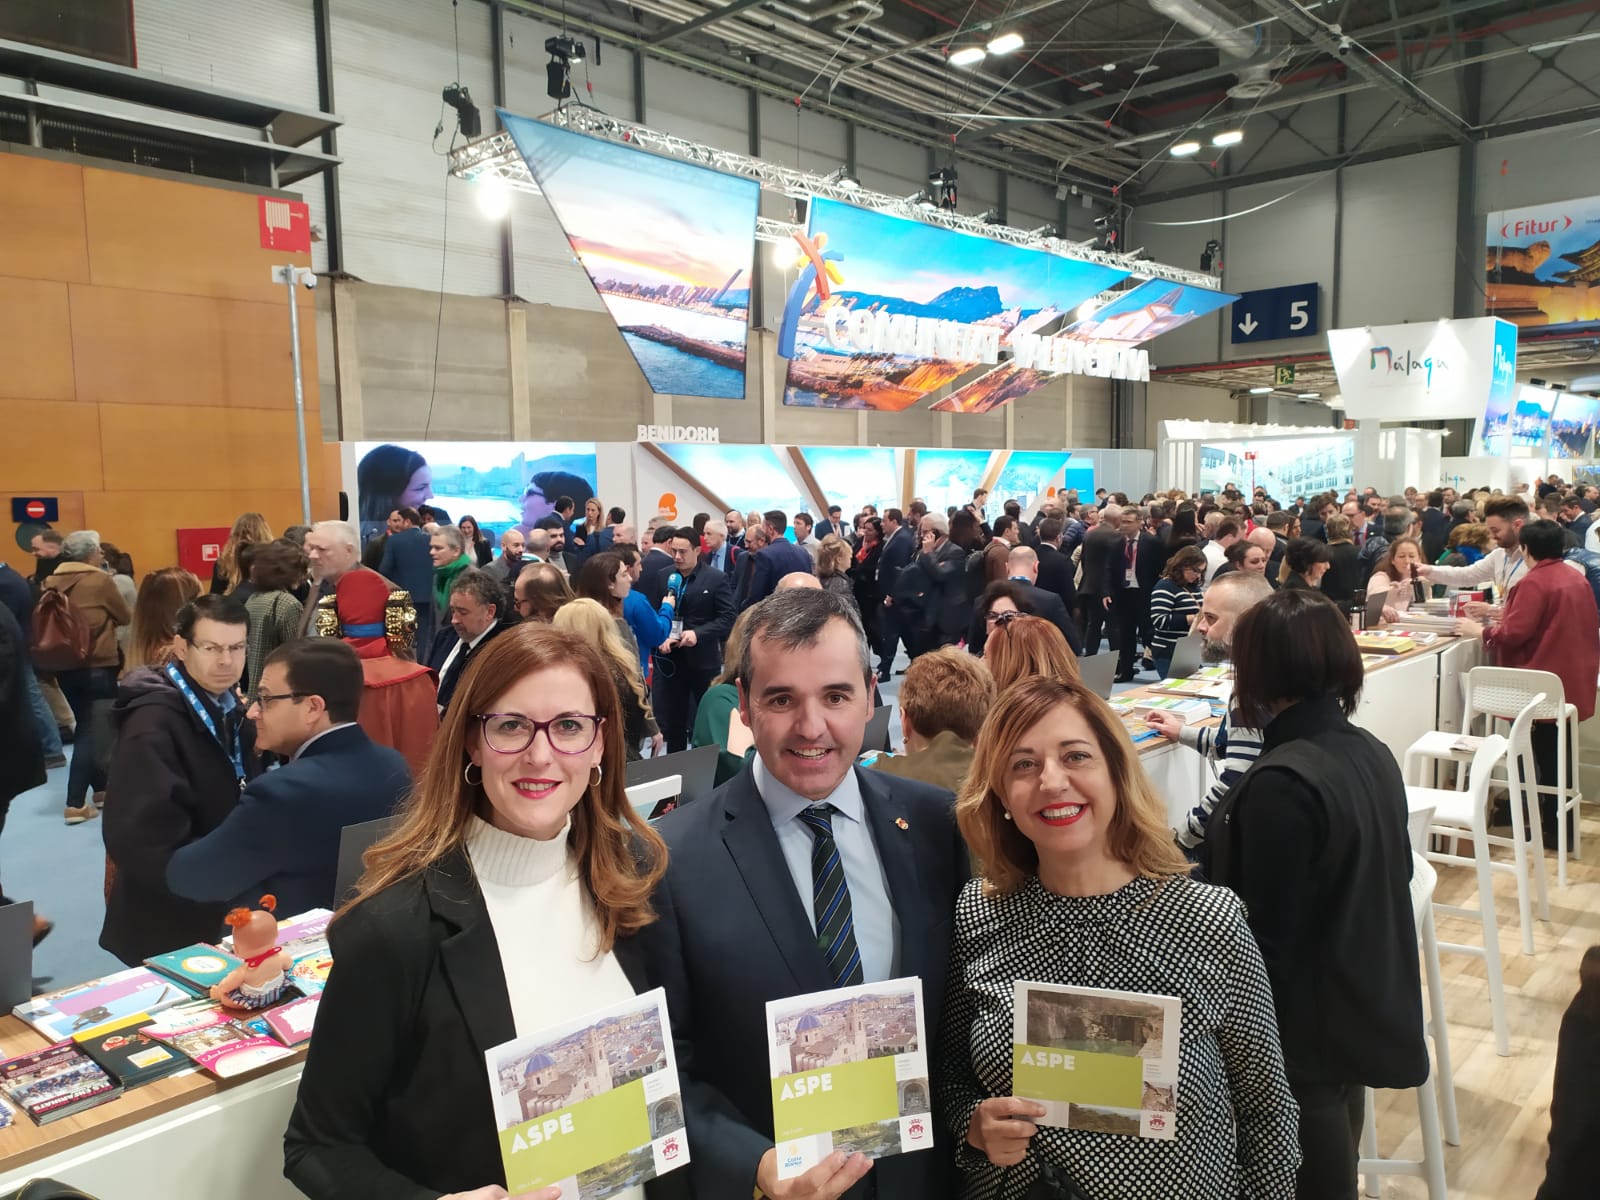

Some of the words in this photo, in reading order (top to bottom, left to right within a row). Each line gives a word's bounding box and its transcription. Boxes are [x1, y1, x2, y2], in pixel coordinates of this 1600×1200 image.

[1514, 219, 1559, 238] Fitur
[1290, 301, 1309, 330] 5
[1369, 346, 1449, 394] Málaga
[637, 425, 720, 443] BENIDORM
[1020, 1050, 1076, 1071] ASPE
[780, 1072, 833, 1101] ASPE
[511, 1113, 575, 1154] ASPE
